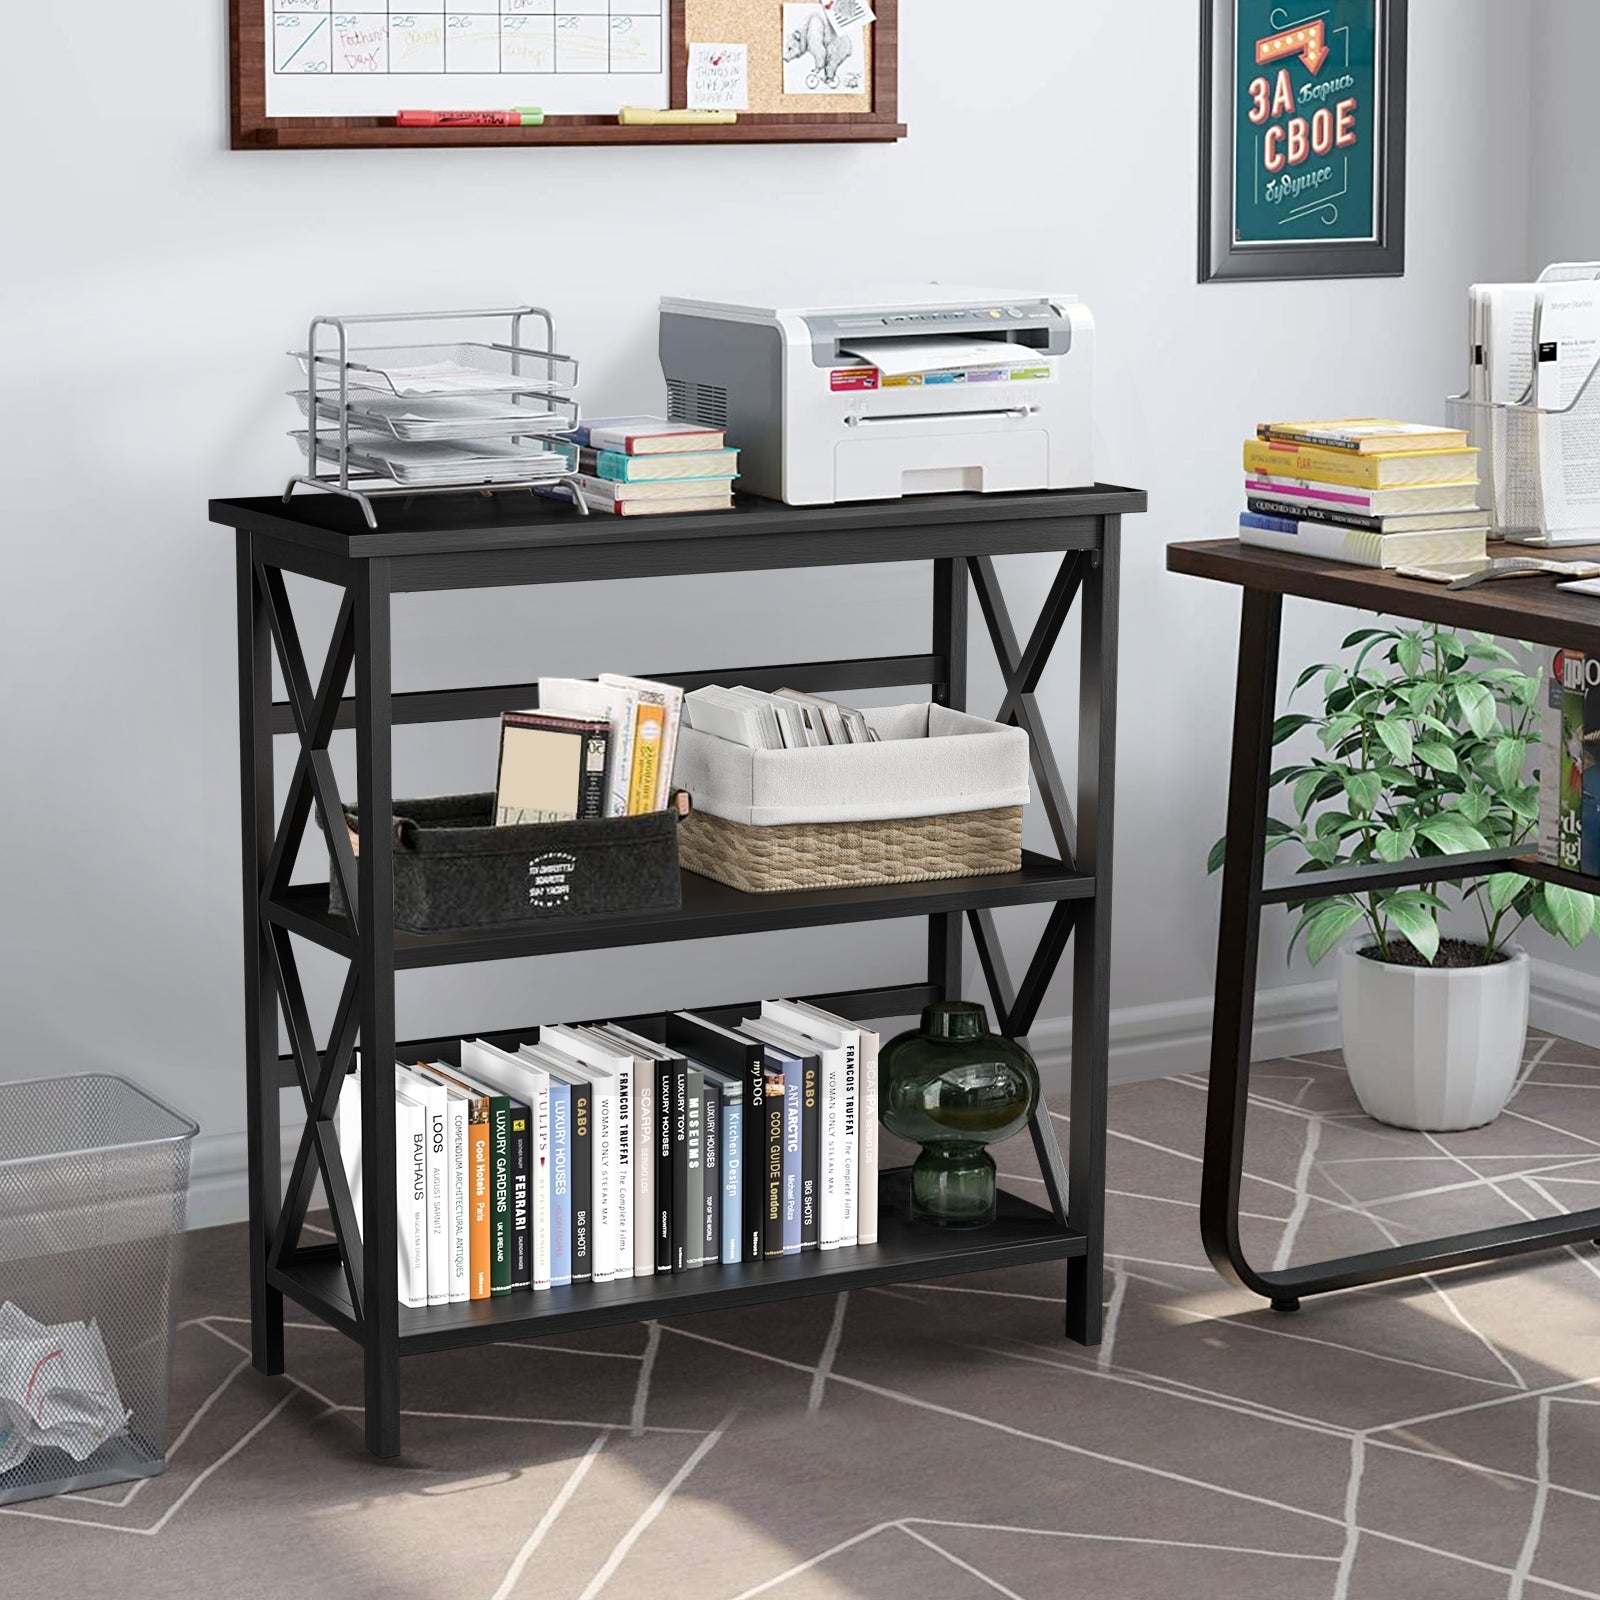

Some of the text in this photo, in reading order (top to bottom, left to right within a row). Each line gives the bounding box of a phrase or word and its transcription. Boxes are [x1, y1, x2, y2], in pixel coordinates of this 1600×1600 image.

[277, 16, 300, 27] 23
[335, 16, 359, 27] 24
[392, 16, 417, 27] 25
[448, 16, 472, 28] 26
[503, 16, 529, 31] 27
[558, 16, 580, 29] 28
[612, 16, 632, 34] 29
[304, 61, 328, 72] 30
[344, 47, 380, 71] Day
[1248, 68, 1295, 124] ЗА
[1298, 74, 1354, 103] Борись
[1264, 98, 1356, 172] СВОЕ
[1265, 166, 1333, 205] будущее
[805, 1070, 815, 1107] GABO
[828, 1072, 836, 1109] WOMAN
[867, 1061, 876, 1115] SCARPA
[433, 1115, 443, 1153] LOOS
[496, 1110, 506, 1155] LUXURY
[539, 1088, 548, 1151] TULIPS
[577, 1098, 587, 1136] GABO
[601, 1099, 609, 1138] WOMAN
[641, 1088, 651, 1144] SCARPA
[677, 1115, 685, 1141] TOYS
[688, 1098, 699, 1169] MUSEUMS
[706, 1101, 715, 1167] LUXURY HOUSES
[787, 1085, 798, 1152] ANTARCTIC
[828, 1113, 836, 1137] ONLY
[843, 1046, 854, 1219] FRANCOIS TRUFFAT The Complete Films
[414, 1134, 424, 1200] BAUHAUS
[555, 1100, 566, 1195] LUXURY HOUSES
[601, 1142, 609, 1167] ONLY
[617, 1073, 628, 1250] FRANCOIS TRUFFAT The Complete Films
[727, 1113, 739, 1196] Kitchen Design
[769, 1112, 780, 1219] COOL GUIDE London
[433, 1168, 441, 1235] AUGUST SARNITZ
[455, 1115, 464, 1277] COMPENDIUM ARCHITECTURAL ANTIQUES
[476, 1141, 485, 1221] Cool Hotels Paris
[497, 1158, 506, 1212] GARDENS
[515, 1175, 526, 1230] FERRARI
[787, 1175, 796, 1198] Michael
[804, 1180, 813, 1225] BIG SHOTS
[497, 1222, 504, 1230] UK
[578, 1211, 586, 1257] BIG SHOTS
